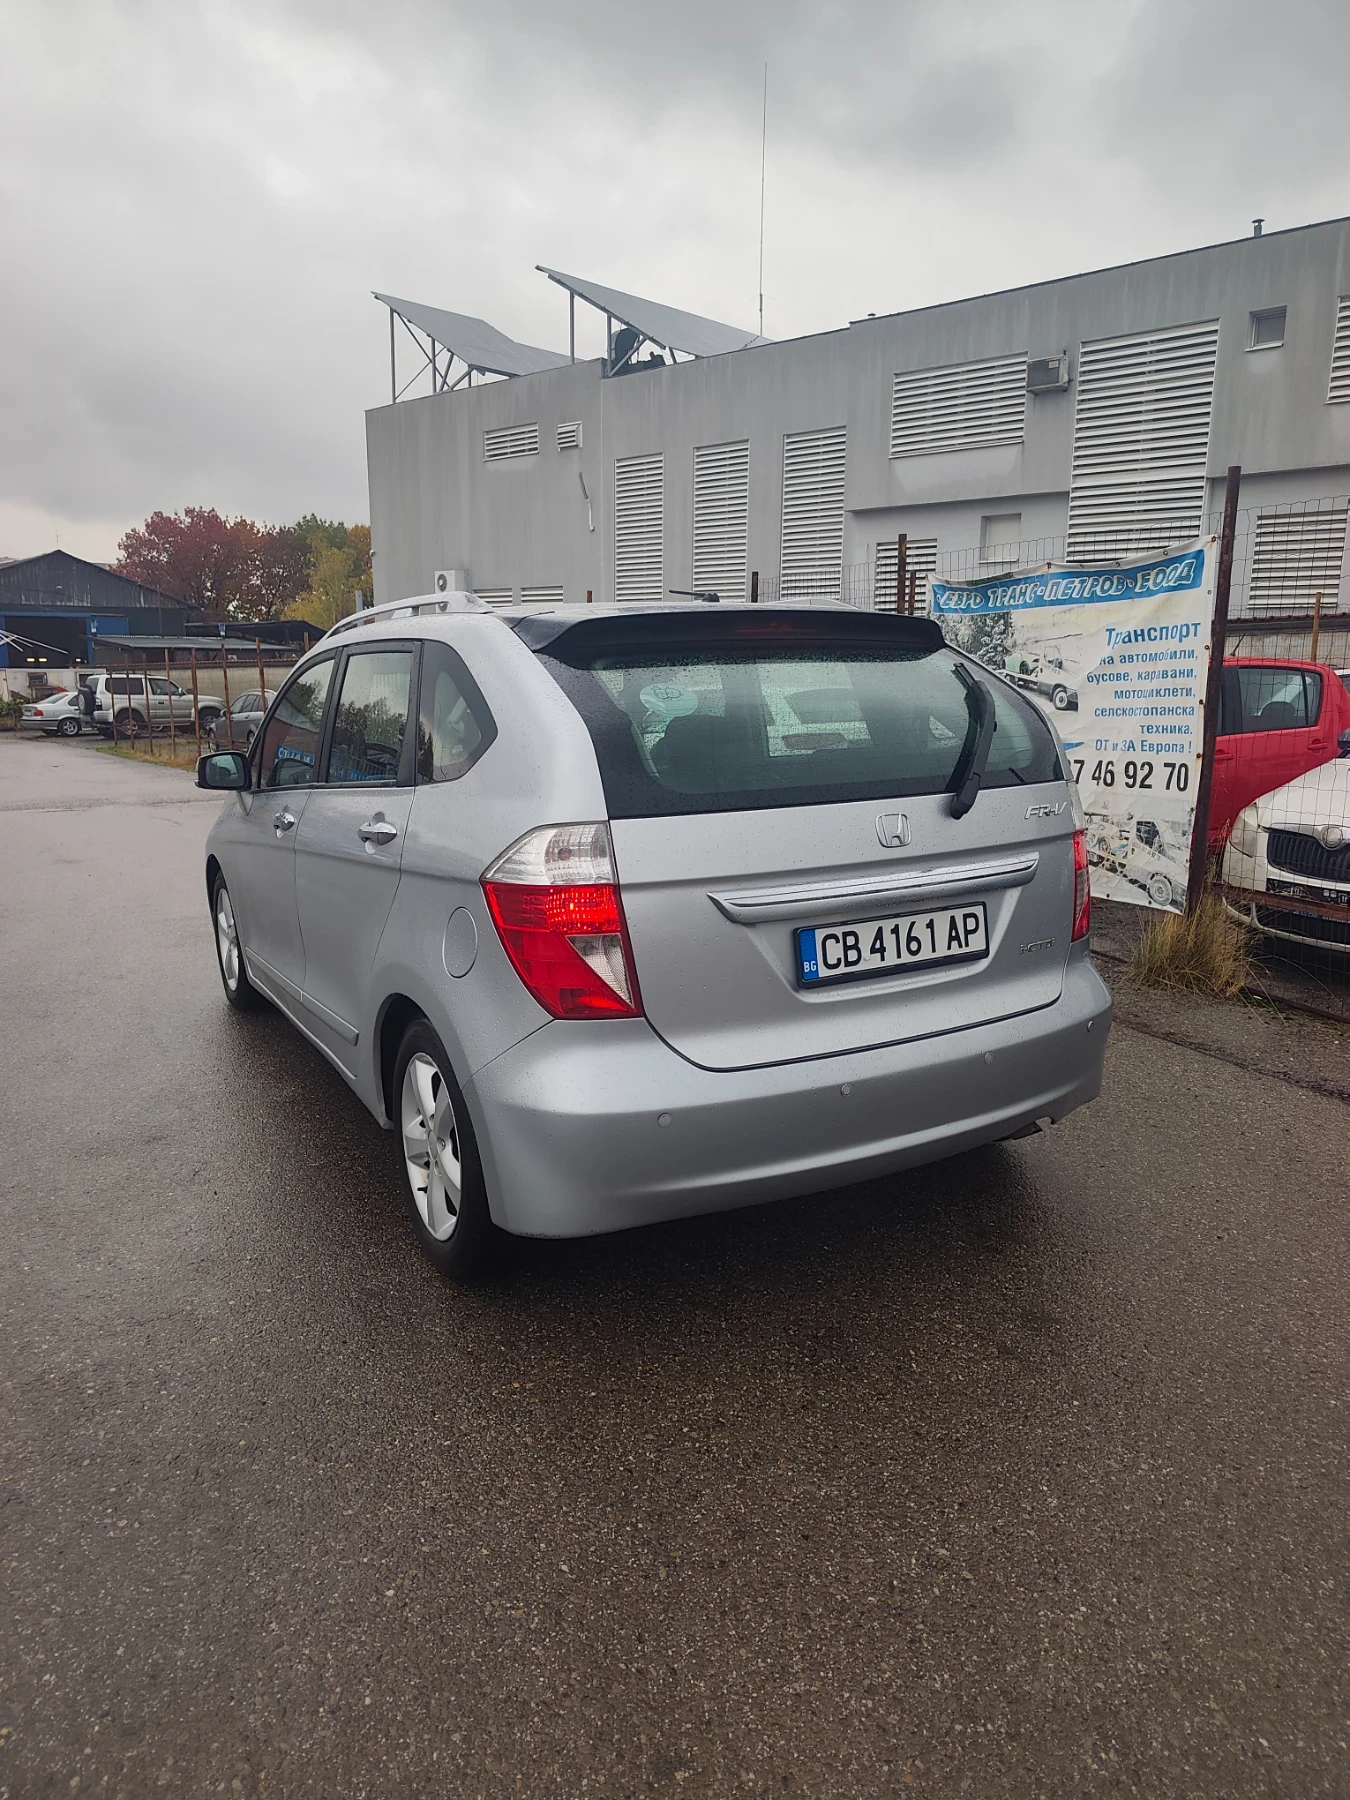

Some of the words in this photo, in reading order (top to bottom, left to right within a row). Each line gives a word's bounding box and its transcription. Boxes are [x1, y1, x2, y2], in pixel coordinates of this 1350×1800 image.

[1106, 622, 1201, 649] Транспорт
[1119, 648, 1198, 663] автомобили,
[1086, 671, 1133, 685] бусове,
[1137, 668, 1197, 683] каравани,
[1114, 687, 1196, 700] мотоциклети,
[1094, 705, 1195, 718] селскостопанска
[1139, 724, 1193, 735] техника.
[1095, 739, 1109, 752] ОТ
[1092, 760, 1115, 787] 46
[1124, 761, 1154, 789] 92
[1163, 762, 1189, 792] 70
[1024, 802, 1067, 819] FR-V
[821, 930, 862, 970] CB
[869, 918, 937, 962] 4161
[947, 912, 980, 951] AP
[803, 961, 817, 973] BG
